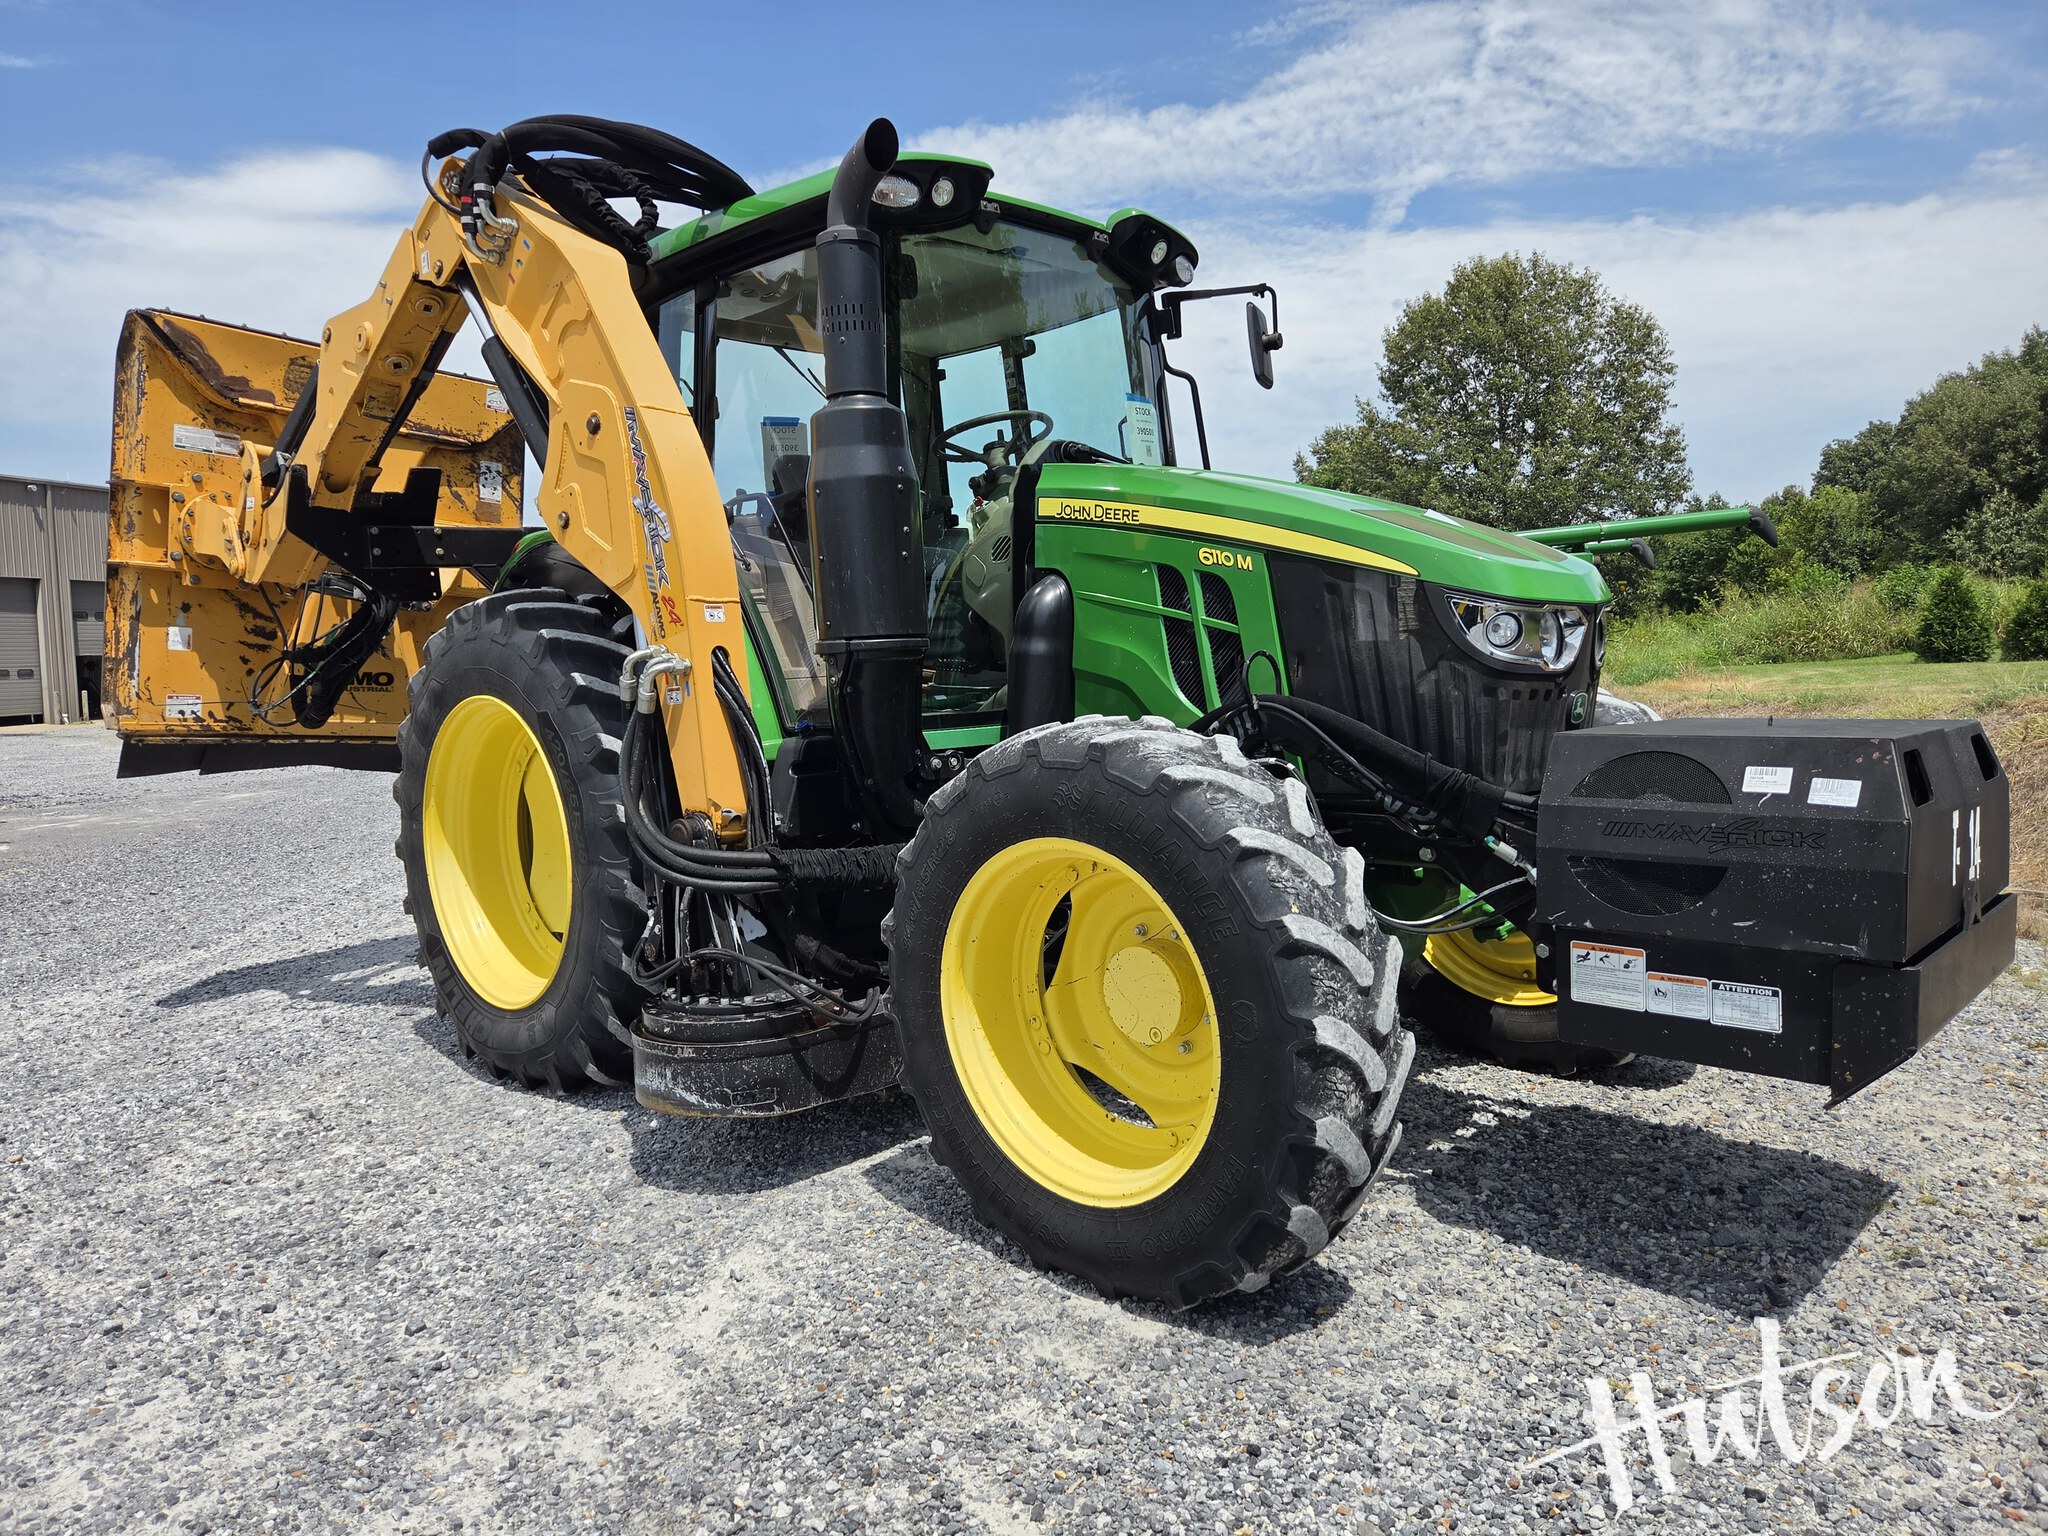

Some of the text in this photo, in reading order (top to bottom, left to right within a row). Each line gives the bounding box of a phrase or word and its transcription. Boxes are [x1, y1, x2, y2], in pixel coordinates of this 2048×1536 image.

[1135, 407, 1151, 416] STOCK
[1056, 502, 1139, 522] JOHN DEERE
[1198, 547, 1235, 566] 6110
[650, 591, 667, 640] ALAMO
[1082, 788, 1241, 943] ALLIANCE
[1718, 983, 1773, 996] ATTENTION
